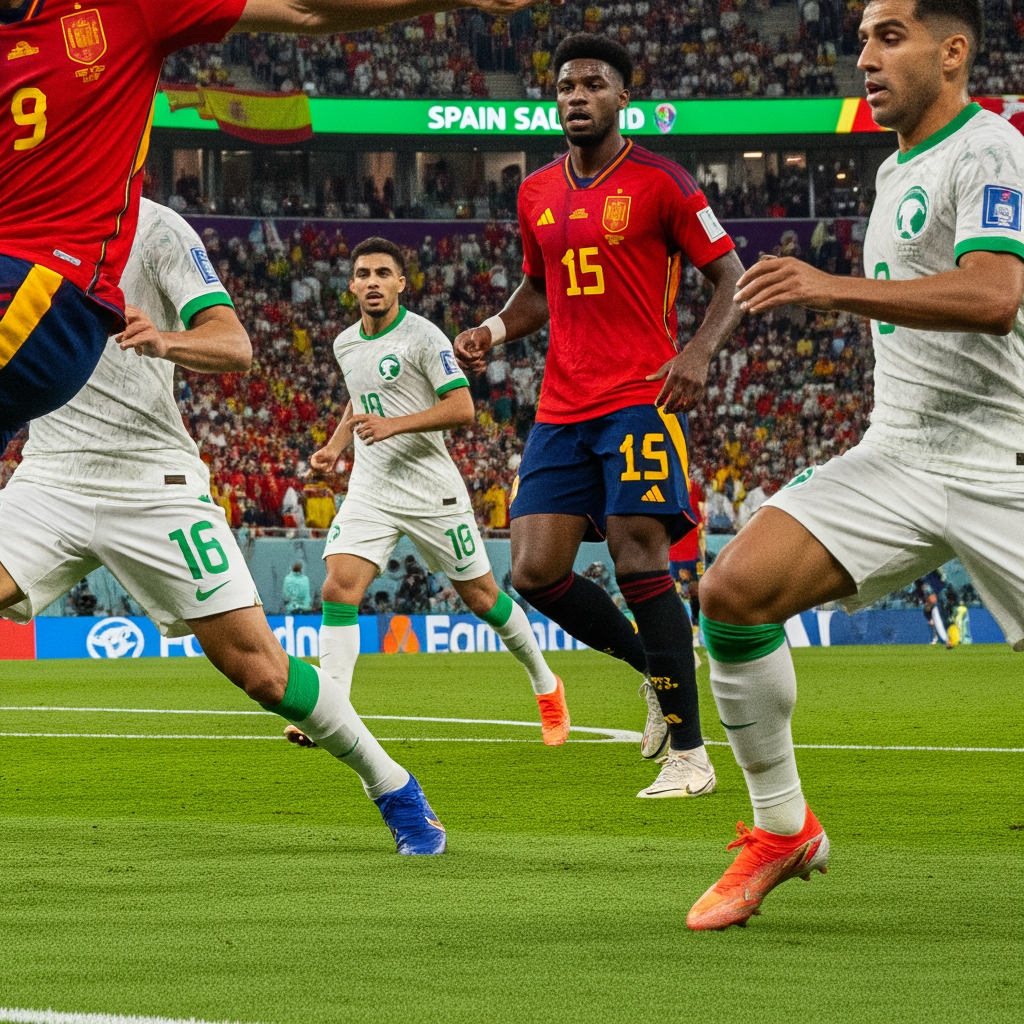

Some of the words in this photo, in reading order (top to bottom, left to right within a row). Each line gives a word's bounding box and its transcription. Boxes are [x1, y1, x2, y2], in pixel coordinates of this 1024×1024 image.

[11, 87, 47, 151] 9
[428, 106, 506, 130] SPAIN
[561, 247, 605, 296] 15
[619, 433, 668, 482] 15
[168, 520, 230, 580] 16
